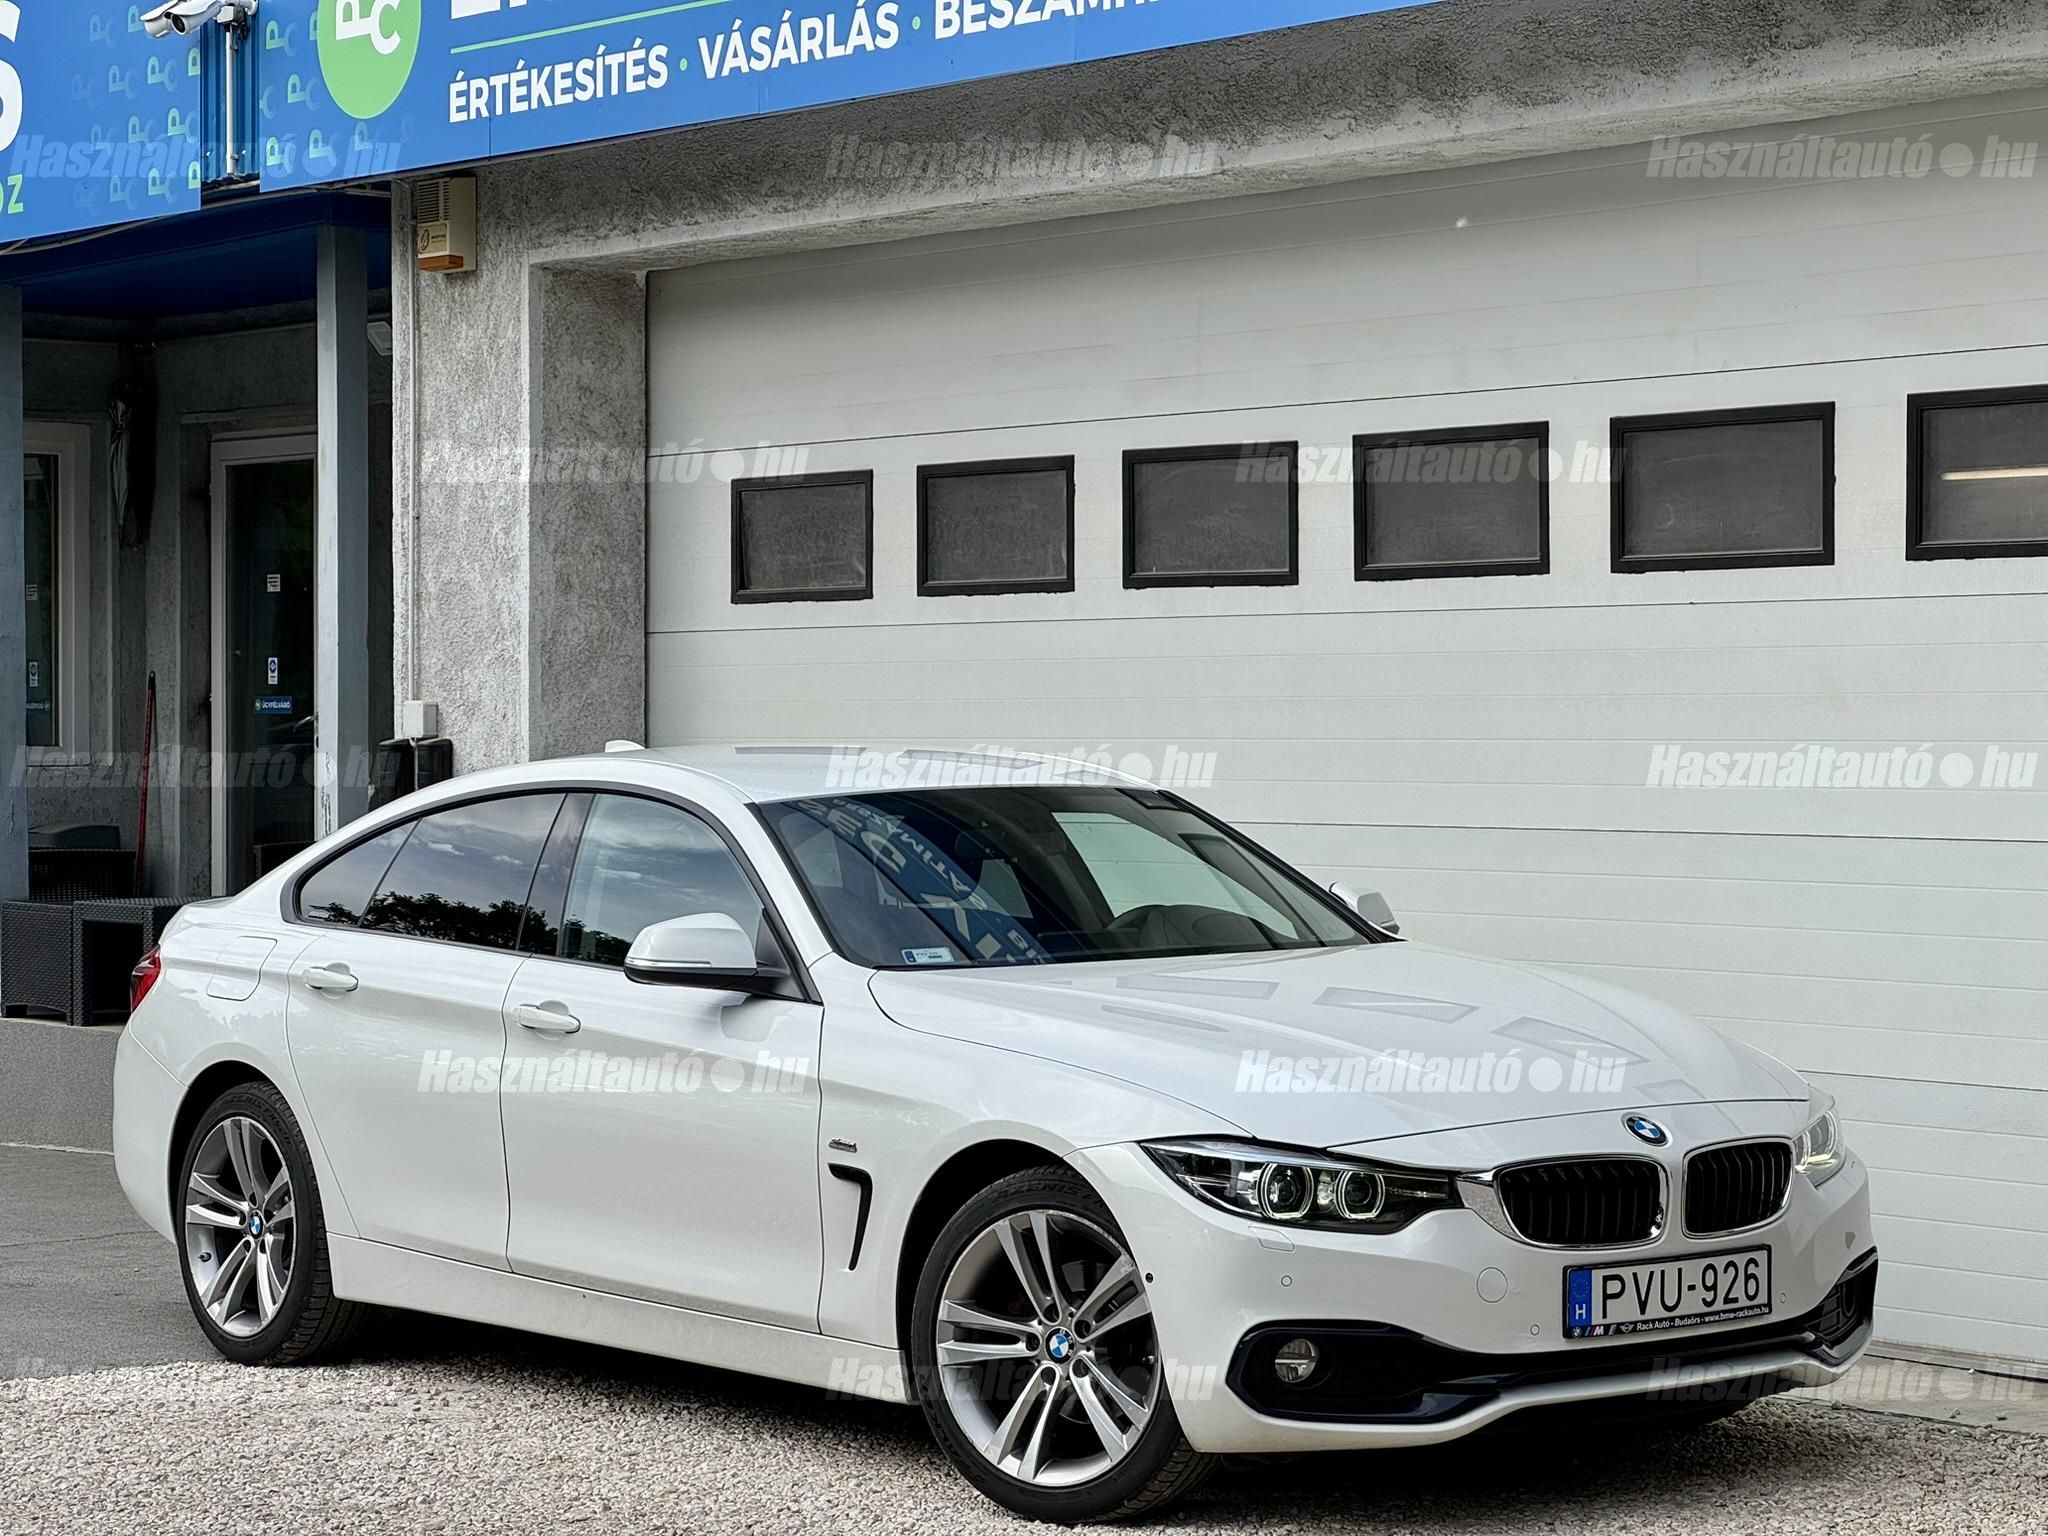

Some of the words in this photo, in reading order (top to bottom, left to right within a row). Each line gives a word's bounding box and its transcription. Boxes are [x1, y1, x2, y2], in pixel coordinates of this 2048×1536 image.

[449, 38, 669, 123] ÉRTÉKESÍTÉS
[698, 0, 900, 79] VÁSÁRLÁS
[1602, 1257, 1760, 1319] PVU-926
[1575, 1303, 1587, 1320] H
[1637, 1320, 1654, 1331] Rack
[1675, 1317, 1701, 1327] Budaörs
